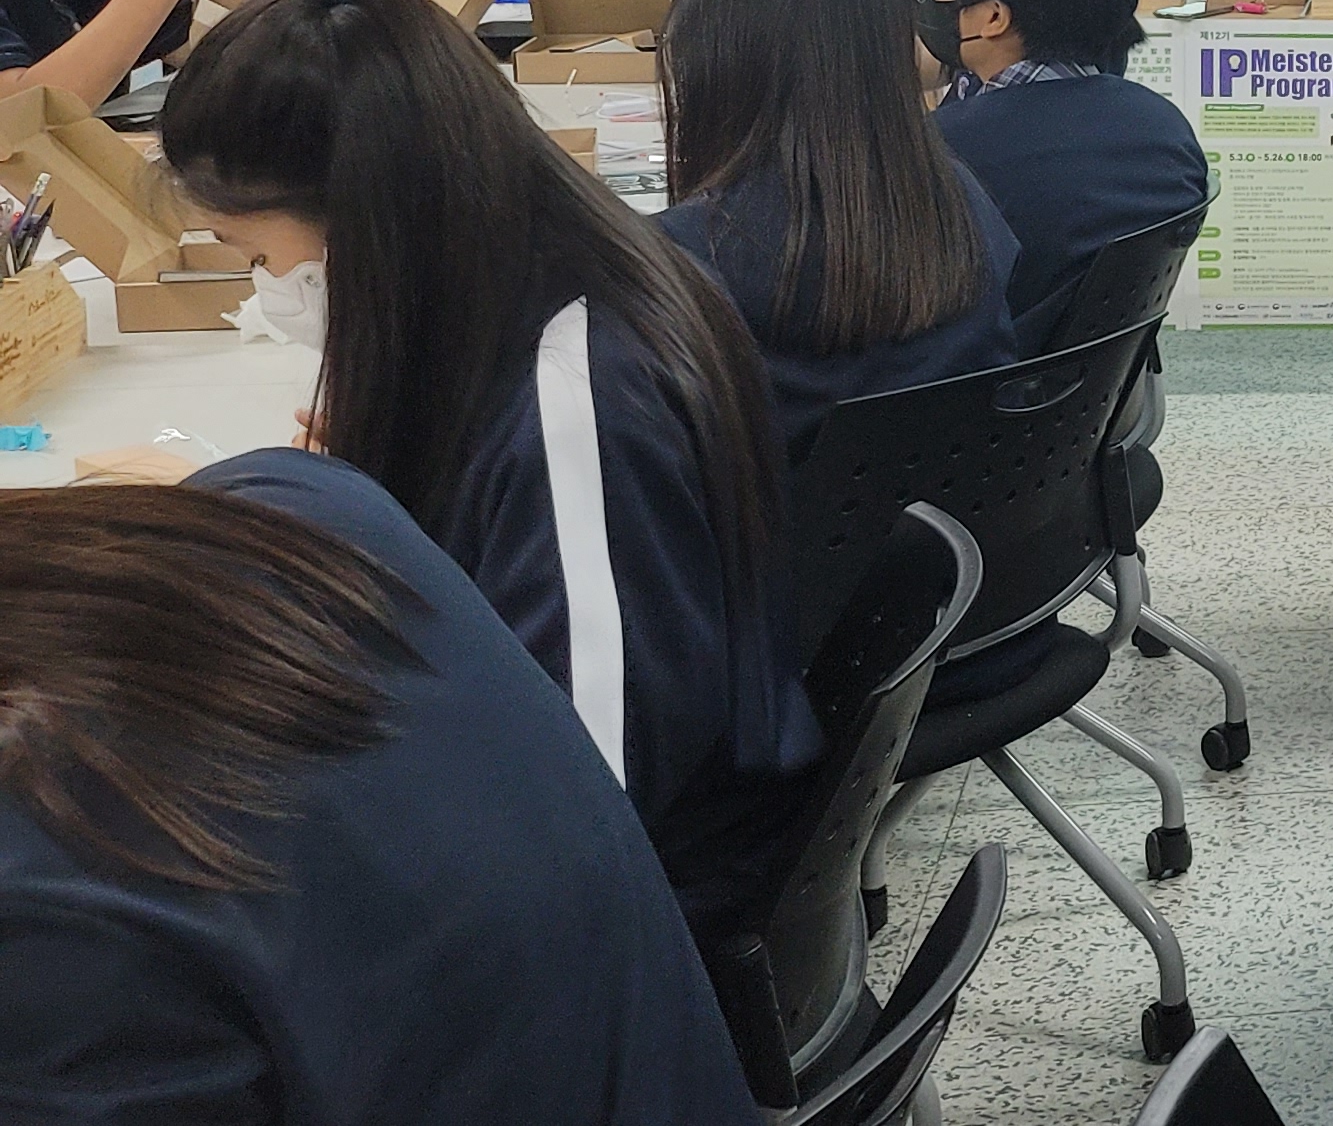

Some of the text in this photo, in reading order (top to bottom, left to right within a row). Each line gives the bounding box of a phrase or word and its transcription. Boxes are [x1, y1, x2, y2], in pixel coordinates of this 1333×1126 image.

[1200, 31, 1230, 41] 제12기
[1200, 48, 1248, 98] IP
[1298, 153, 1322, 162] 18:00
